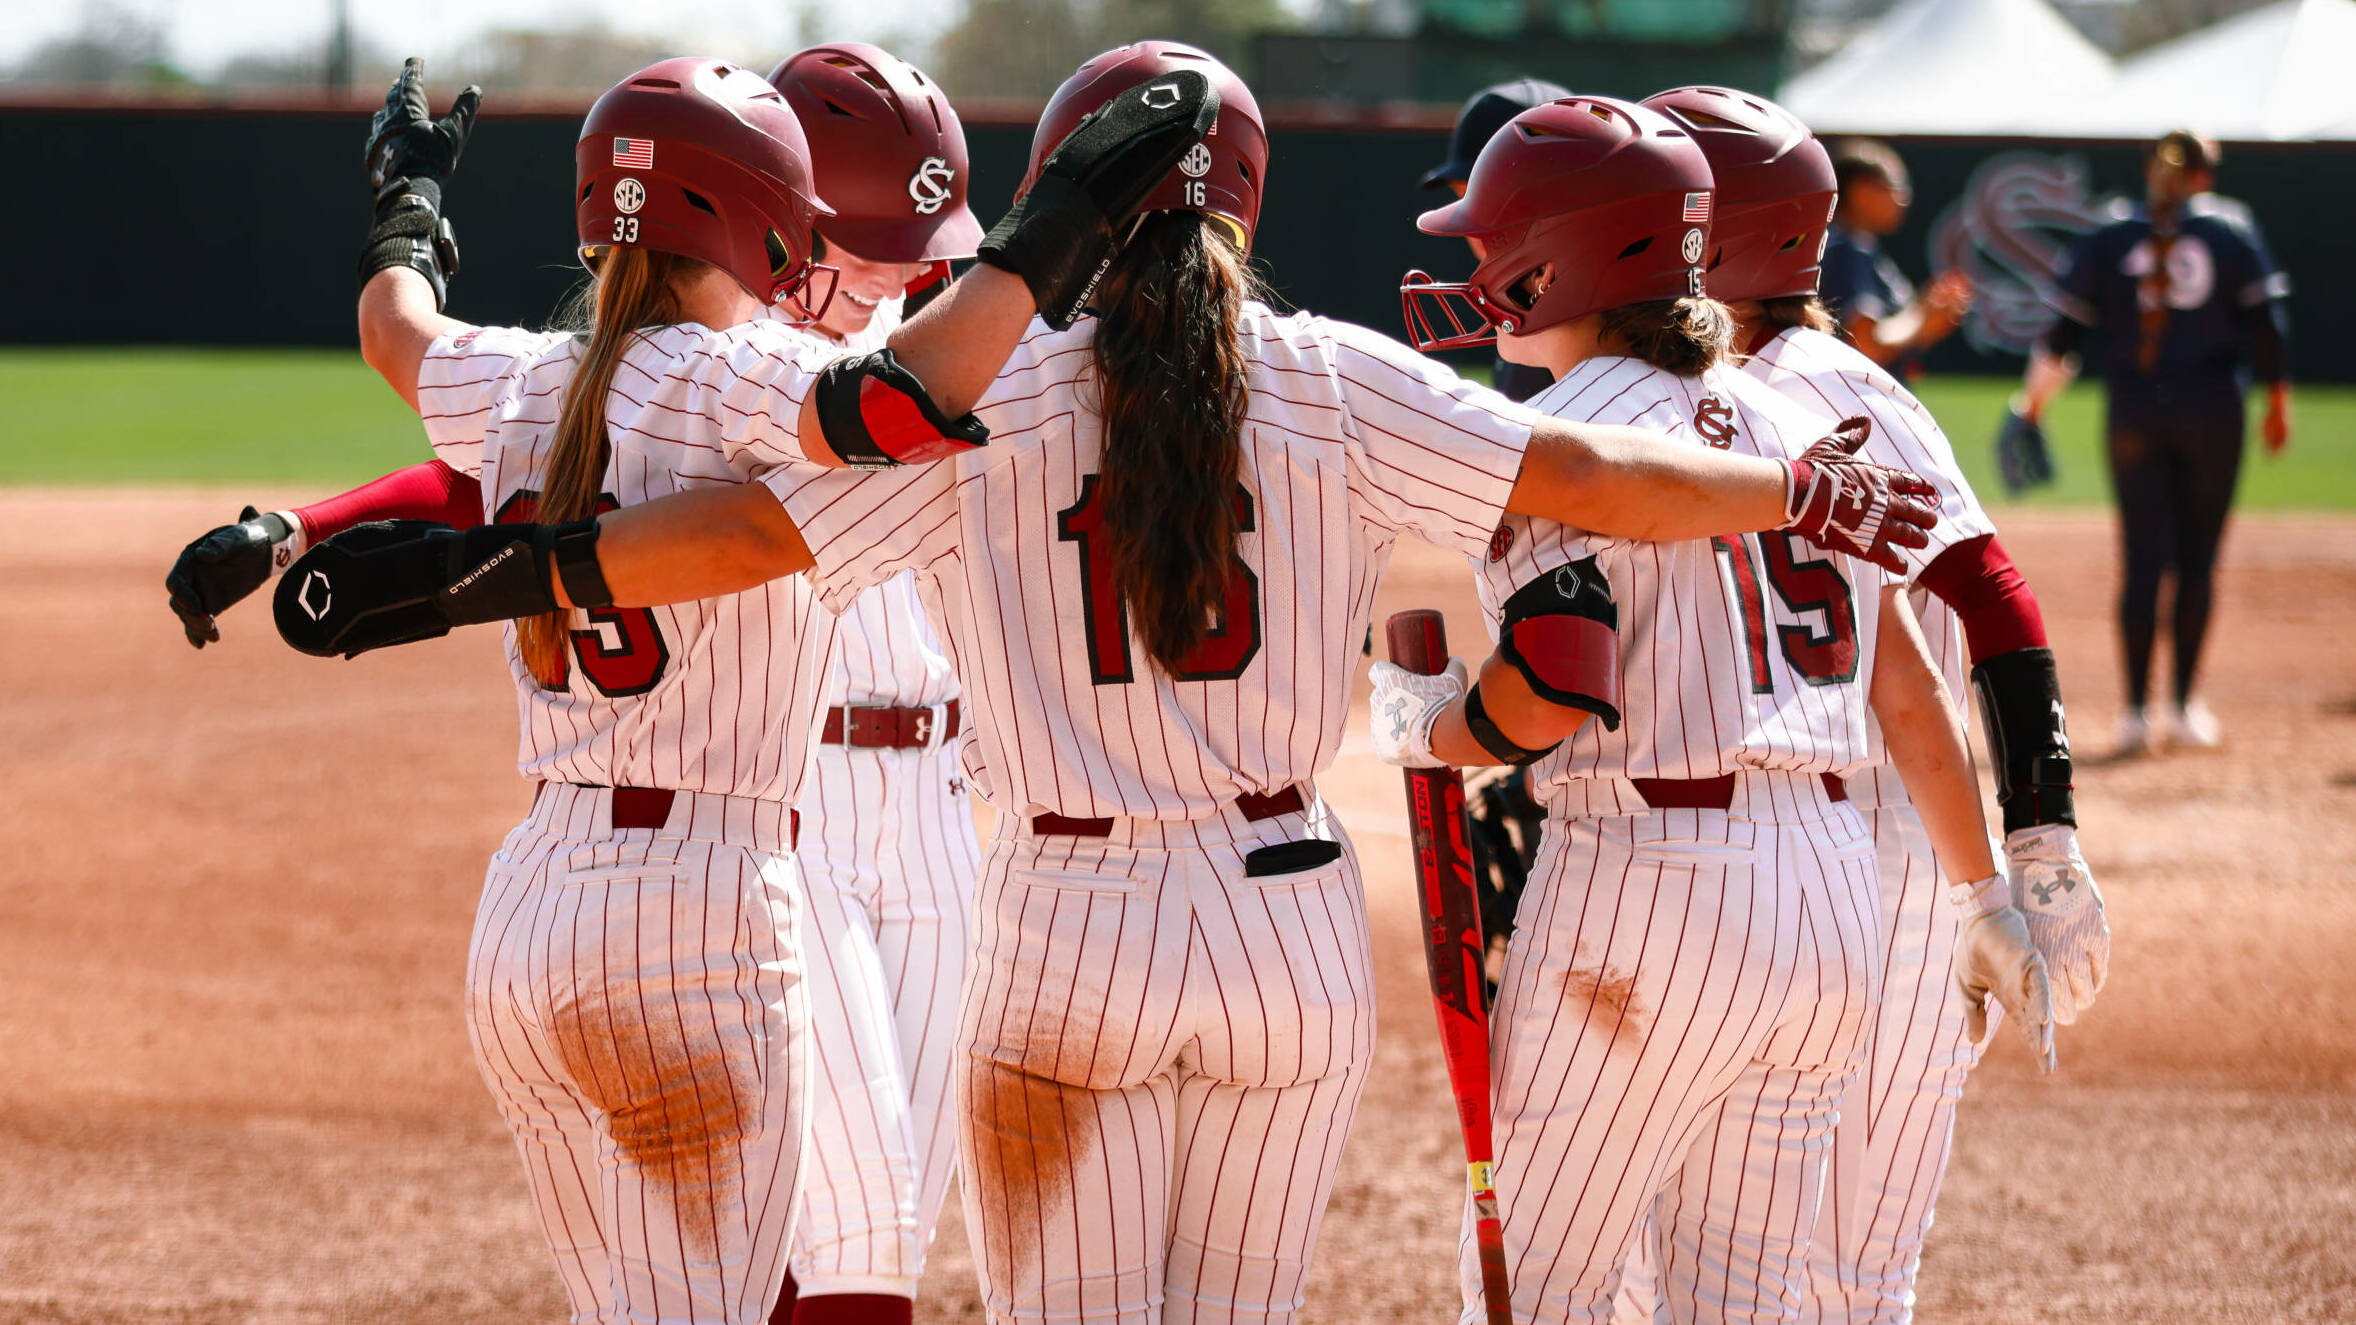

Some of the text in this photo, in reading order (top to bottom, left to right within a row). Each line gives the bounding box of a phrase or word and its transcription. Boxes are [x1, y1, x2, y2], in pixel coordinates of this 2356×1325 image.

[616, 180, 642, 212] SEC
[1184, 181, 1206, 207] 16
[612, 216, 639, 243] 33
[1065, 259, 1110, 323] EVOSHIELD
[449, 548, 514, 594] EVOSHIELD
[1713, 529, 1860, 694] 15
